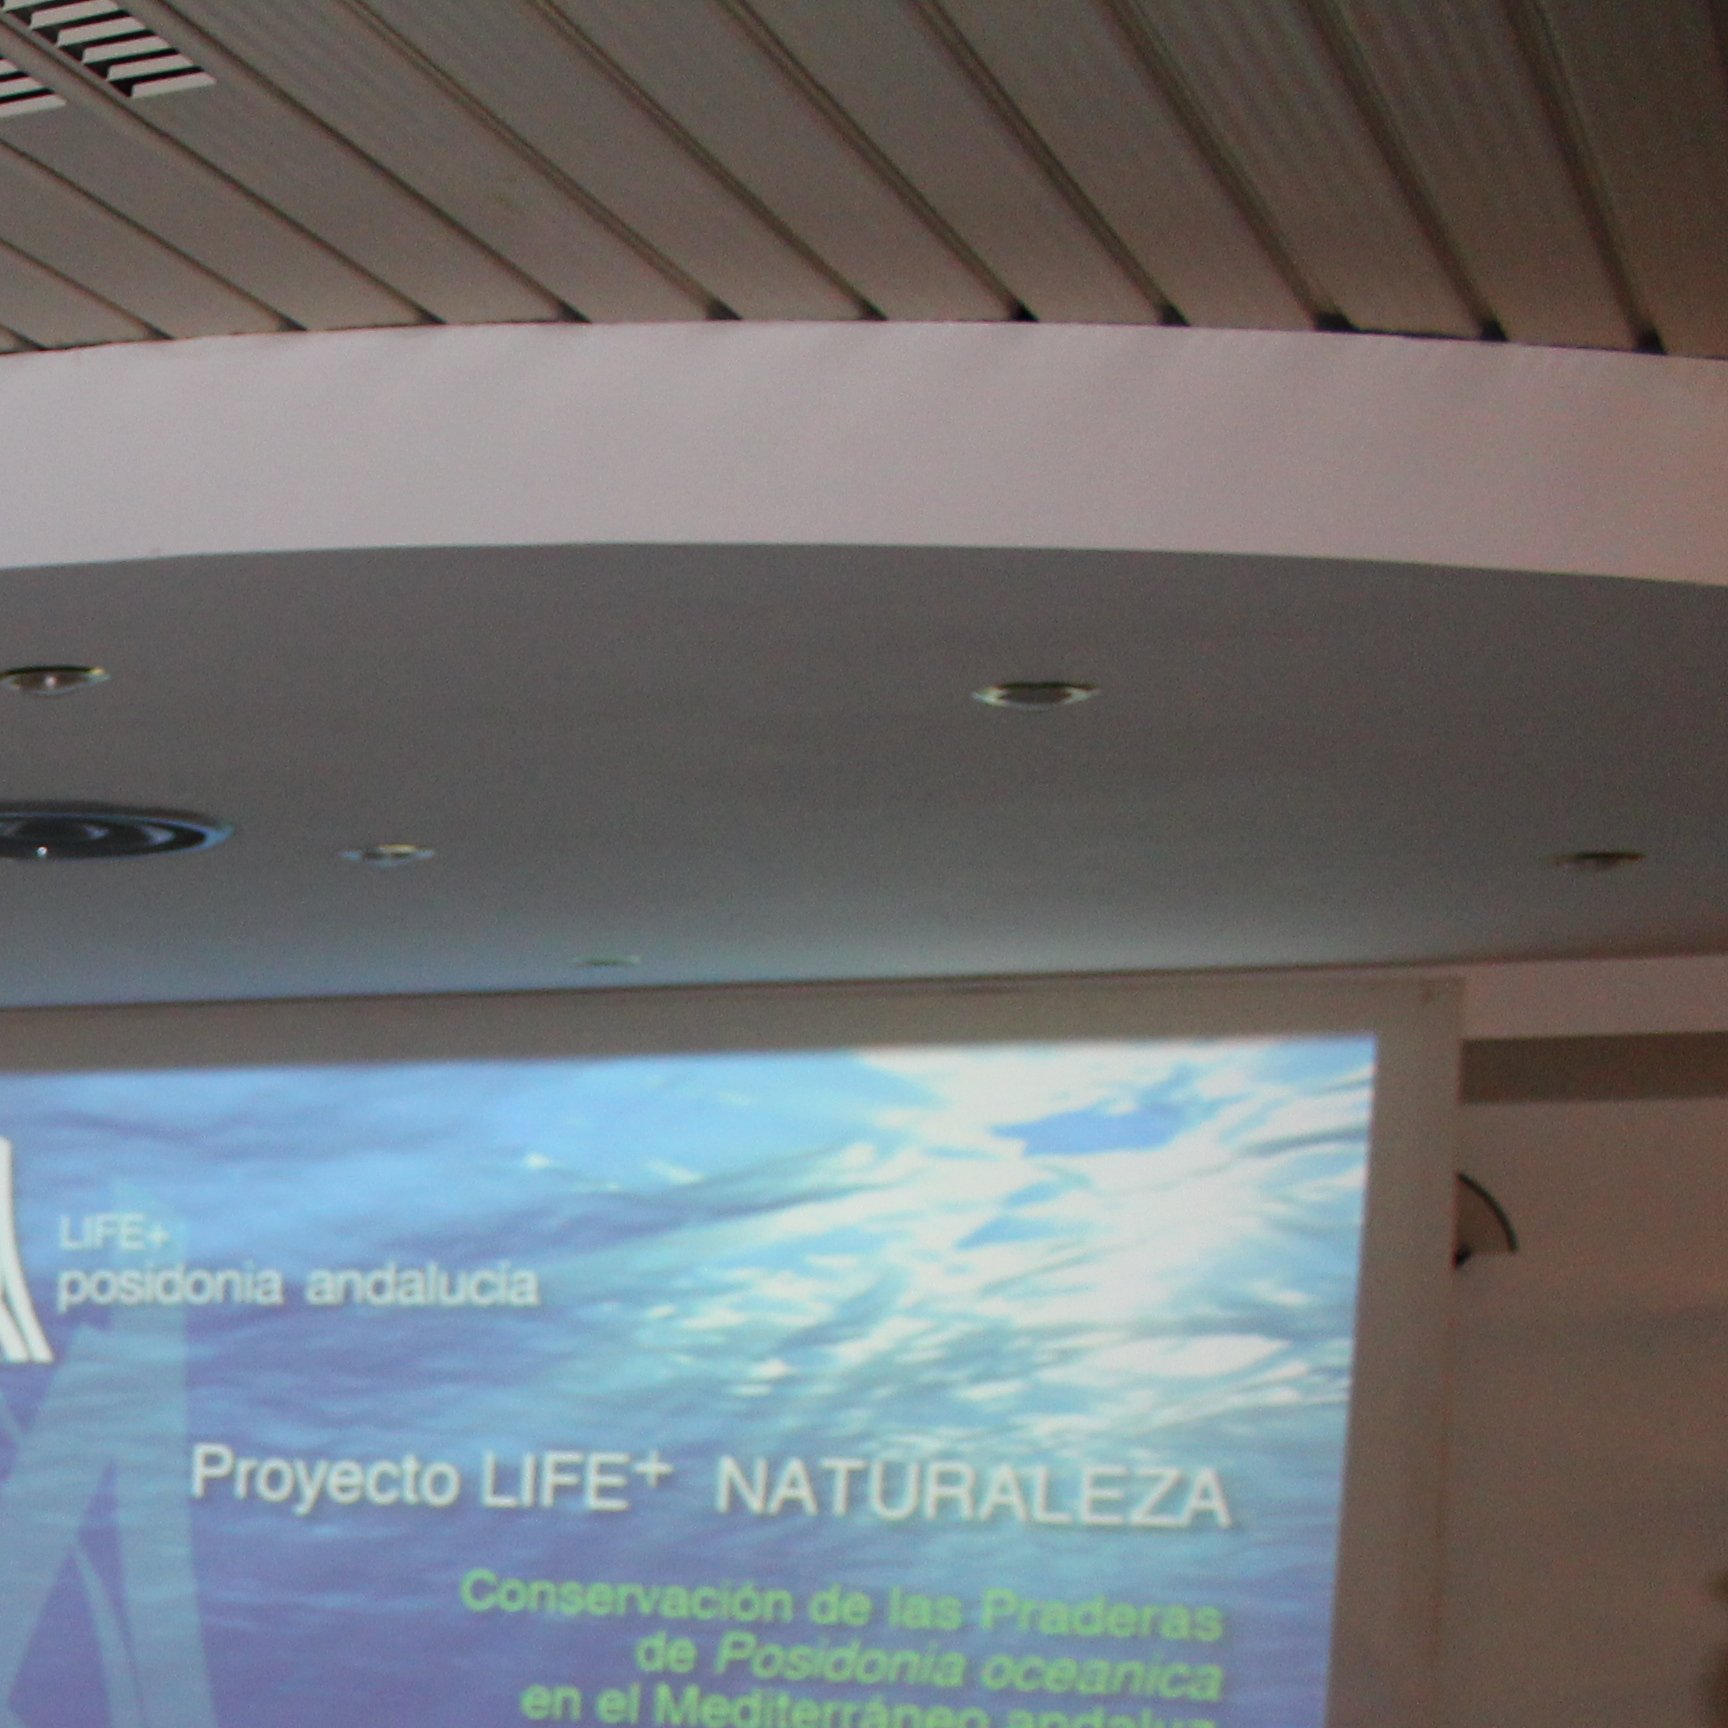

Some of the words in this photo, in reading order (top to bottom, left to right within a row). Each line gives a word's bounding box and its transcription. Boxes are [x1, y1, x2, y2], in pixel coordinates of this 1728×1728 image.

[59, 1213, 170, 1250] LIFE+
[58, 1264, 284, 1314] posidonia
[192, 1442, 461, 1515] Proyecto
[482, 1449, 675, 1512] LIFE+
[717, 1454, 1232, 1529] NATURALEZA
[460, 1568, 794, 1624] Conservación
[808, 1582, 872, 1626] de
[888, 1585, 964, 1631] las
[980, 1587, 1226, 1643] Praderas
[634, 1630, 698, 1675] de
[714, 1630, 968, 1688] Posidonia
[980, 1650, 1226, 1701] oceanica
[519, 1685, 582, 1721] en
[595, 1683, 641, 1726] el
